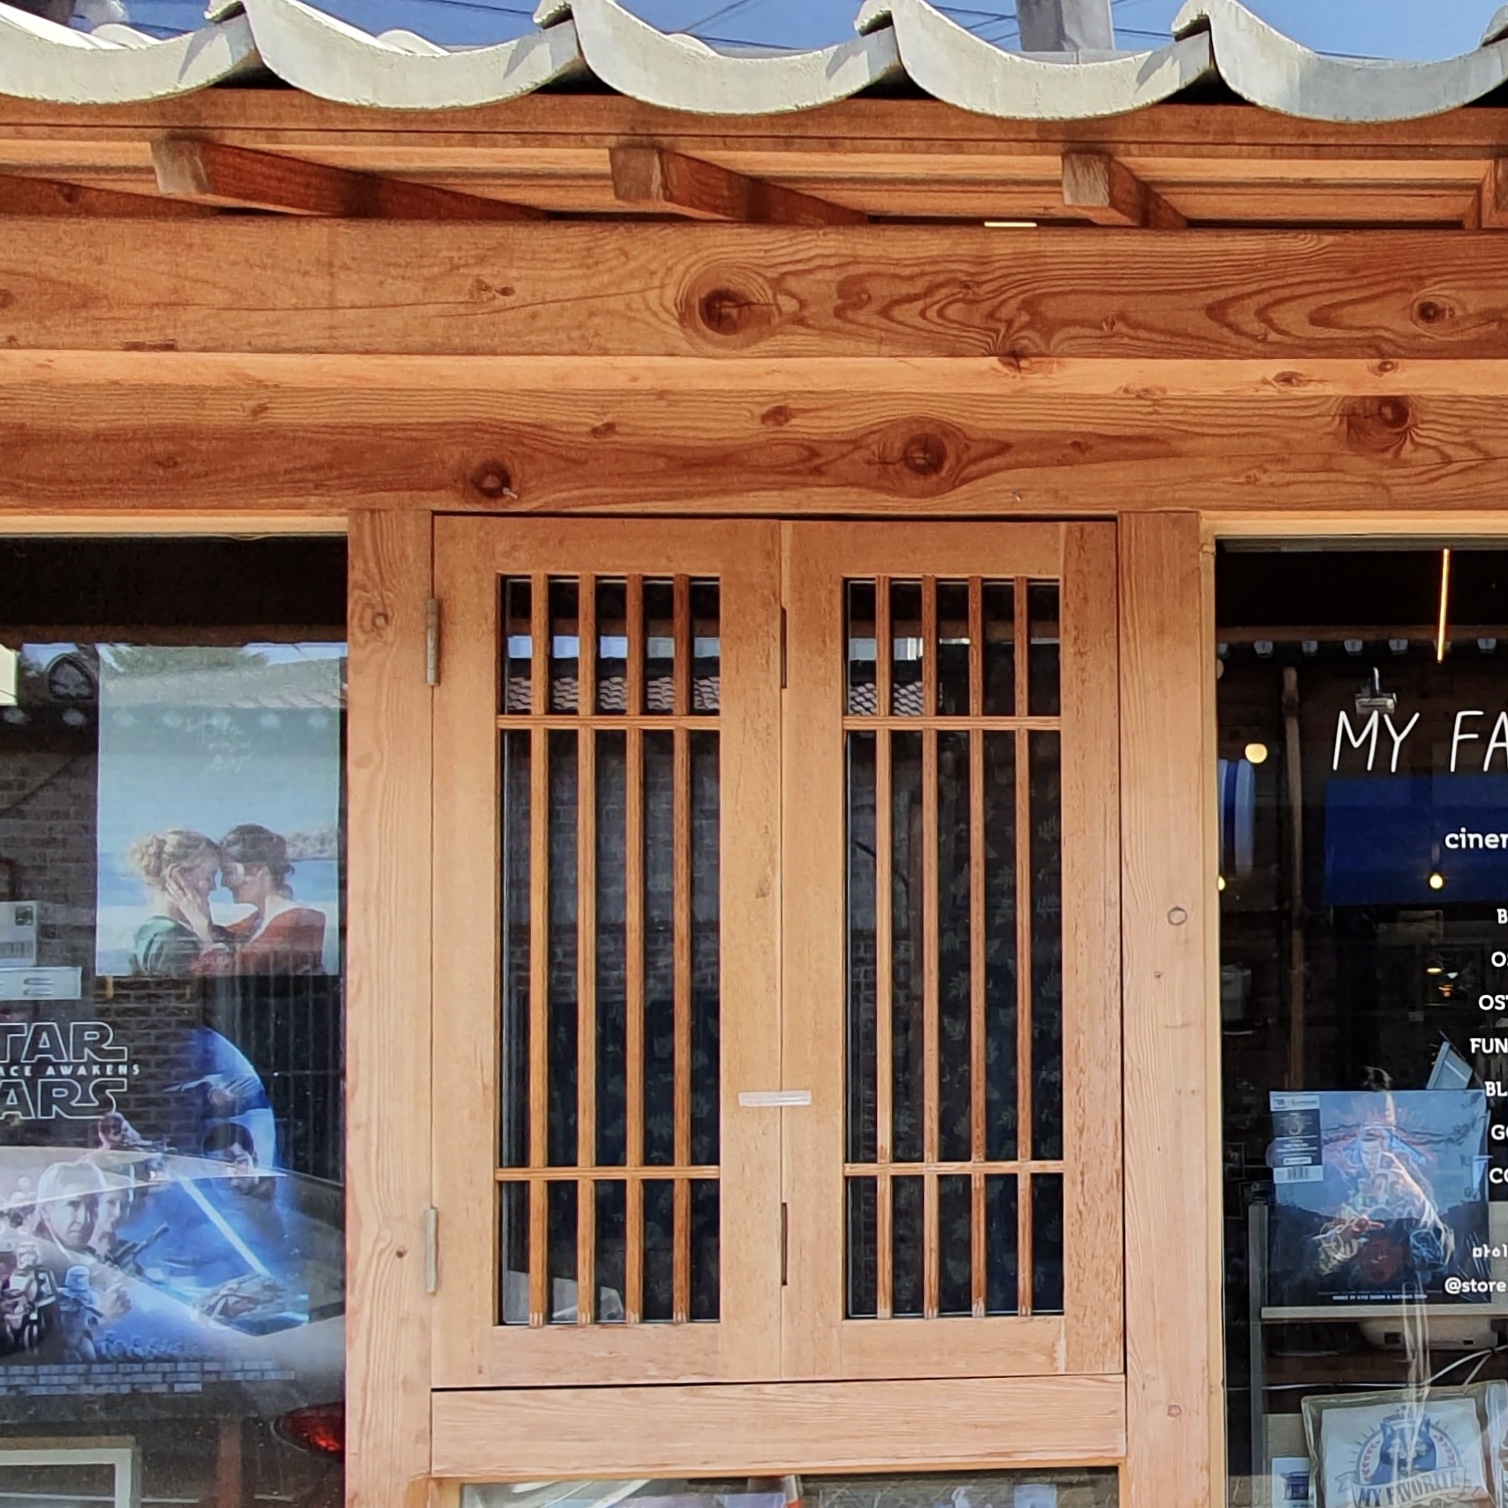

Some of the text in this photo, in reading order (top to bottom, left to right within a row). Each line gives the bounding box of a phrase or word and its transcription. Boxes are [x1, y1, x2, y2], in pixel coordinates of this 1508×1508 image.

[1332, 710, 1419, 773] MY
[45, 1064, 140, 1076] AWAKENS
[1358, 1487, 1384, 1507] MY
